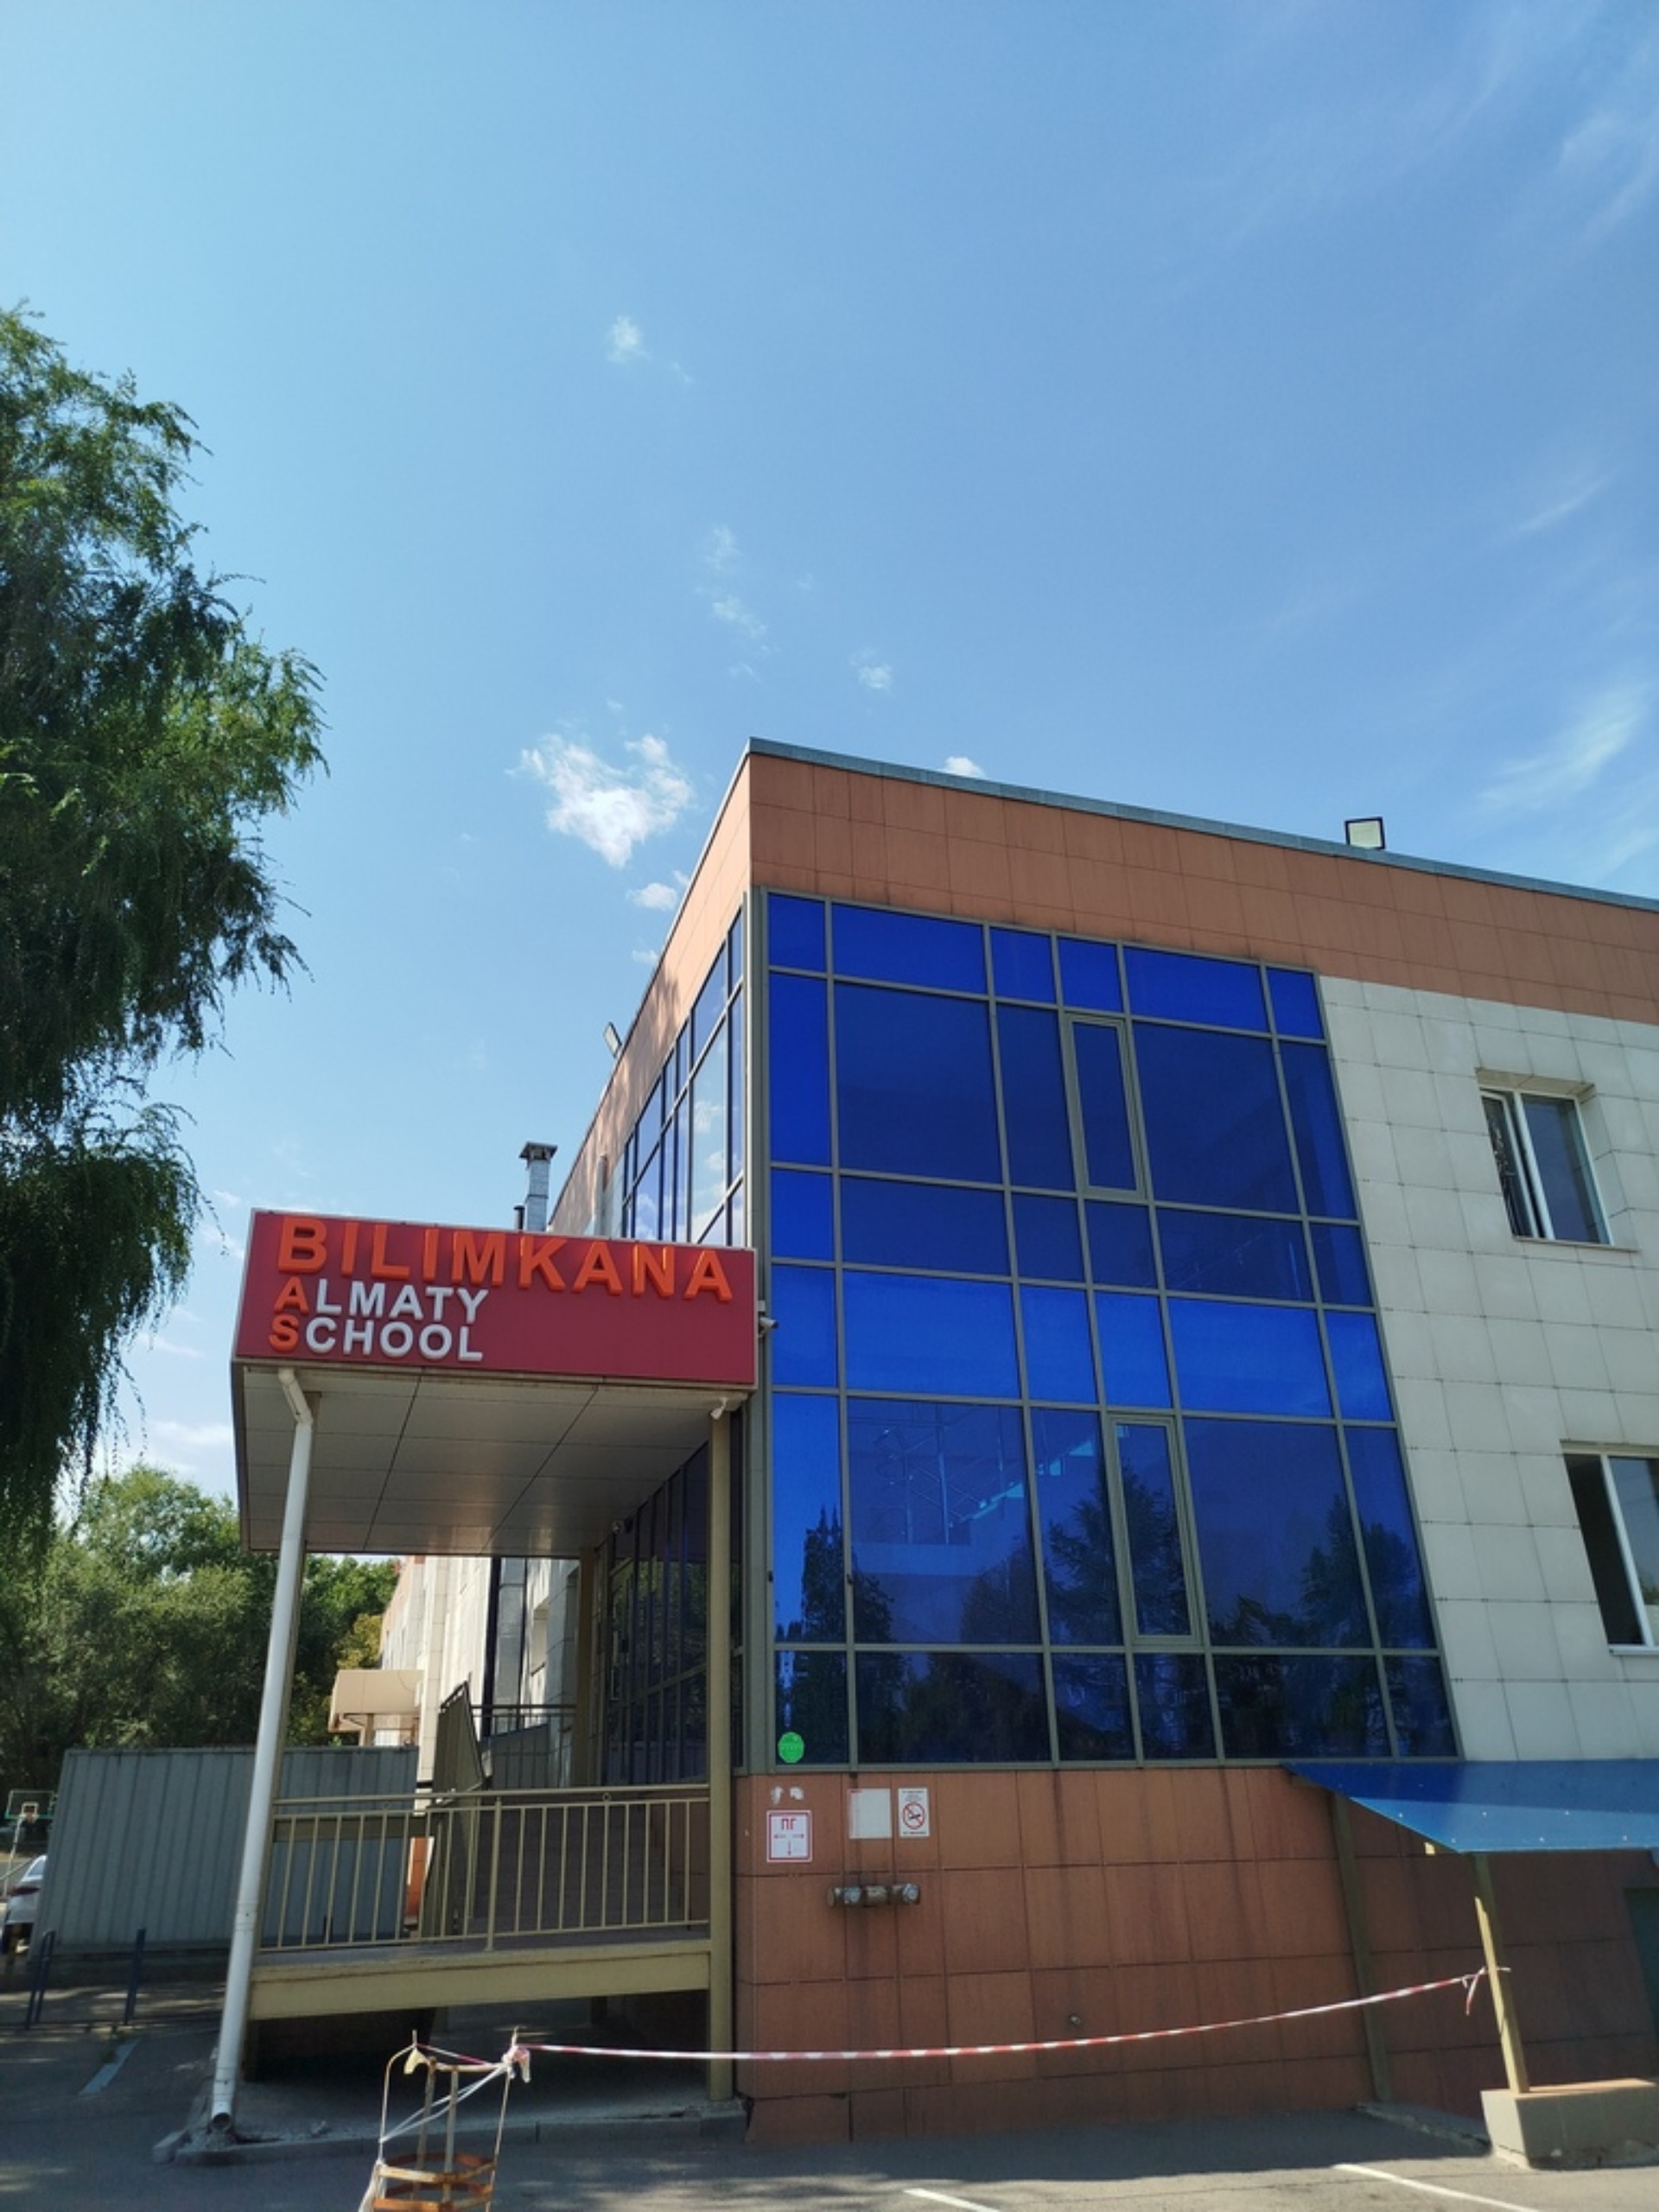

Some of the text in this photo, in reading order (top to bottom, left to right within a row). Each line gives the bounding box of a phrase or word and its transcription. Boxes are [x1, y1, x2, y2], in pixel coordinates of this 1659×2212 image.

[277, 1216, 734, 1302] BILIMKANA
[273, 1275, 489, 1325] ALMATY
[268, 1313, 484, 1362] SCHOOL
[781, 1818, 797, 1830] ПГ
